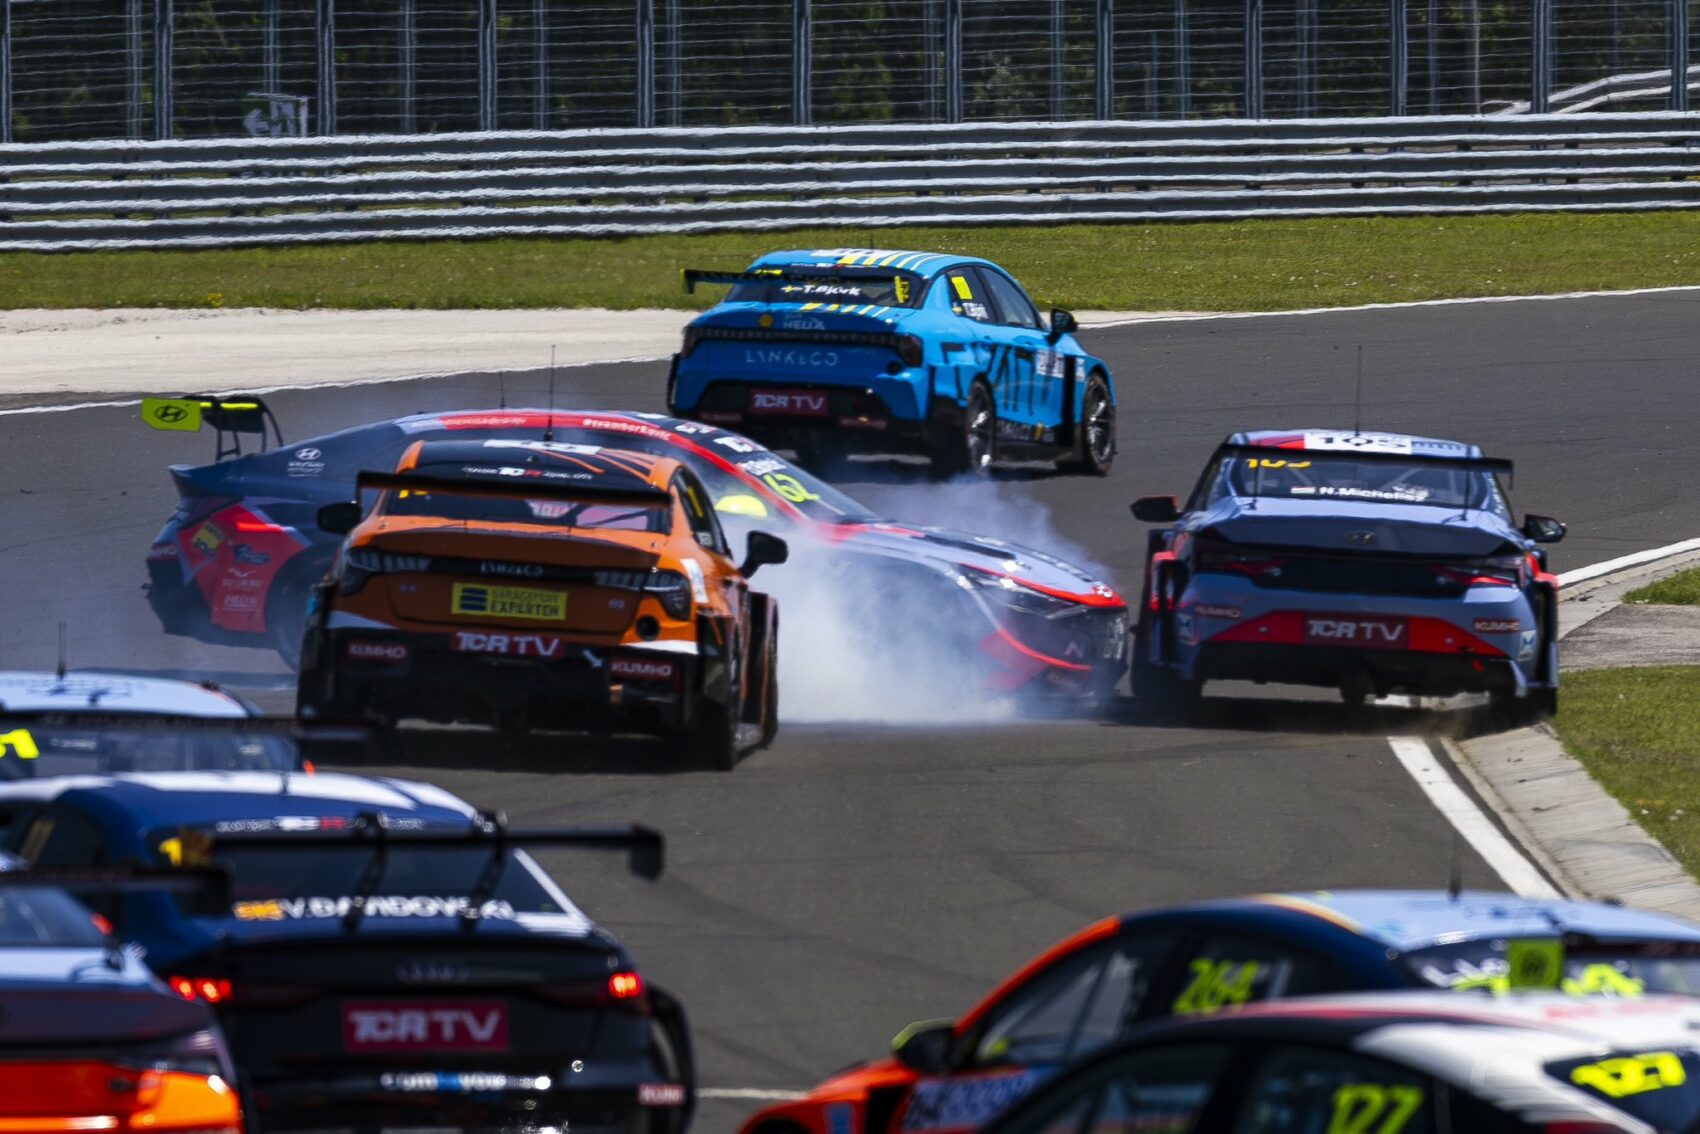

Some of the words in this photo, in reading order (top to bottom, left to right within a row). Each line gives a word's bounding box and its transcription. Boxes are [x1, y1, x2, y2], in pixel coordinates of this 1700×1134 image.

[754, 394, 789, 408] TCR
[792, 396, 824, 410] TV
[1307, 619, 1356, 638] TCR
[1359, 622, 1403, 641] TV
[456, 631, 510, 653] TCR
[513, 635, 560, 656] TV
[611, 661, 672, 677] KUMHO
[348, 1008, 428, 1044] TCR
[431, 1008, 502, 1043] TV
